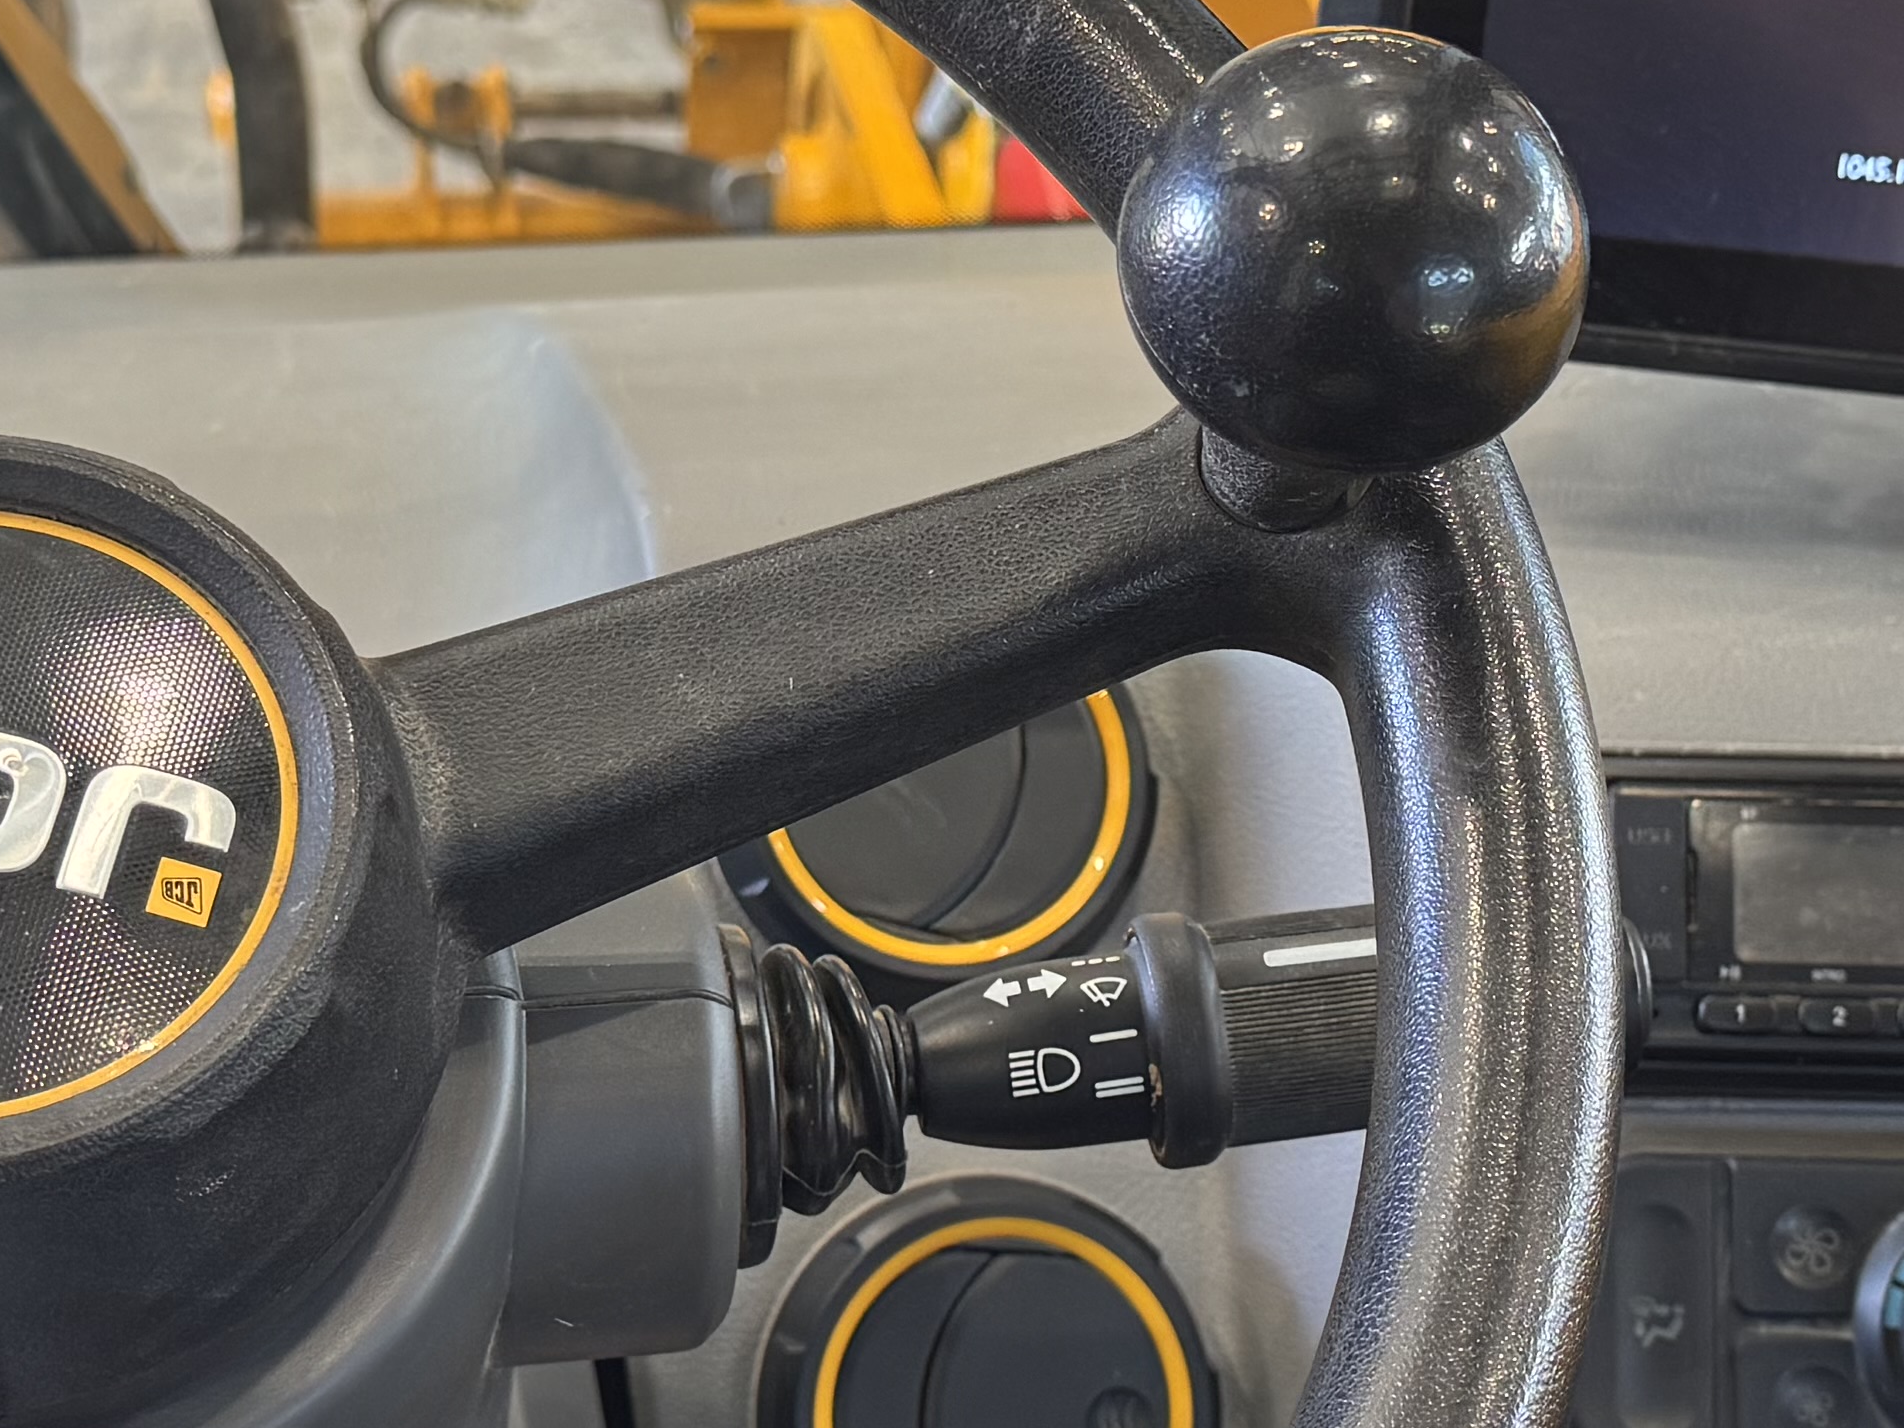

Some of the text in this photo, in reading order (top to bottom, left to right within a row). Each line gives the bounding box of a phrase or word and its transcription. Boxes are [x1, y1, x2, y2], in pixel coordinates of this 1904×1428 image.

[164, 880, 199, 909] JCB
[1735, 1003, 1746, 1023] 1
[1832, 1006, 1847, 1027] 2
